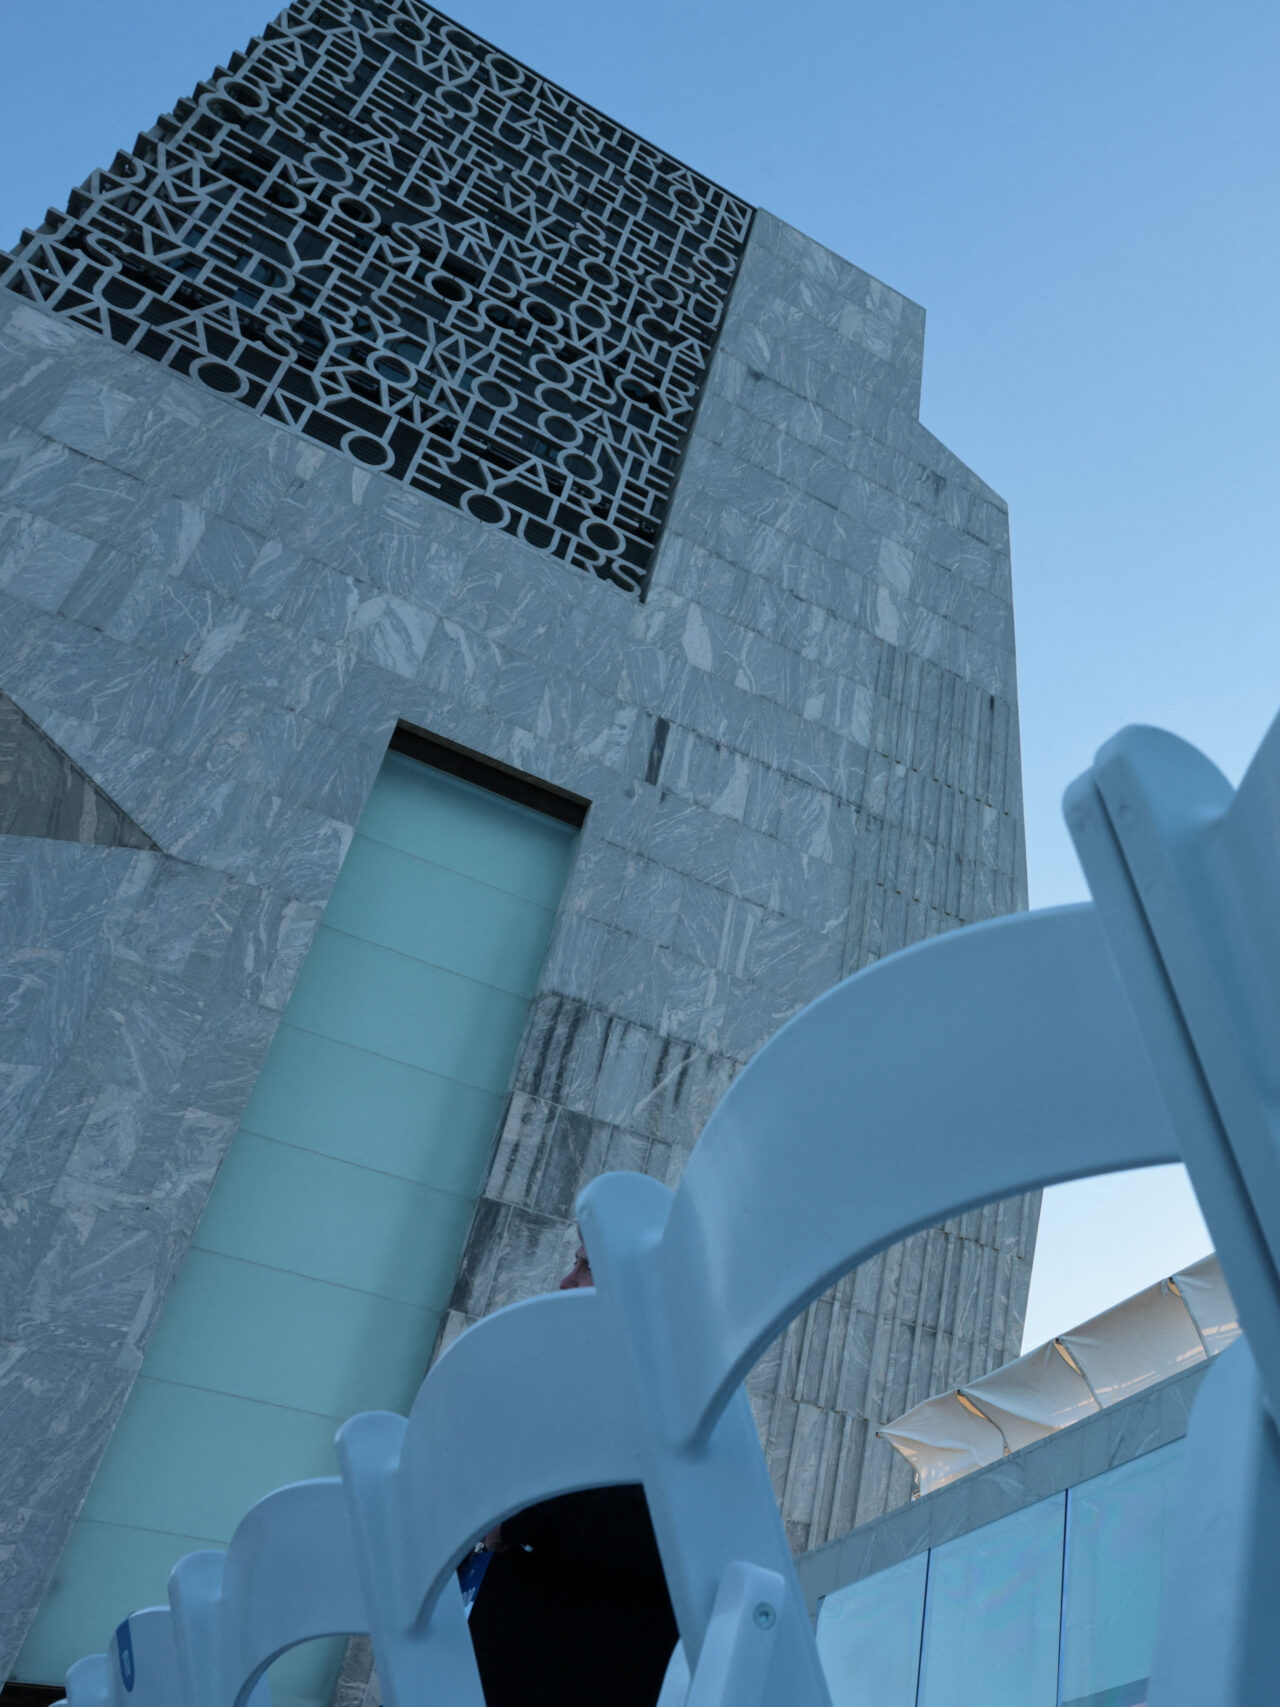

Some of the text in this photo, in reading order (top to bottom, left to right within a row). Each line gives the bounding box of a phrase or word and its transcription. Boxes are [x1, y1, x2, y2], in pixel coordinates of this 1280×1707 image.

[262, 29, 727, 311] ARE FIRST STEPS
[266, 155, 452, 270] MOST
[345, 100, 409, 145] IS
[416, 139, 558, 233] NEW
[404, 44, 573, 155] WHAT
[602, 161, 652, 204] IS
[430, 81, 648, 221] OUGHT
[674, 223, 737, 275] TO
[519, 154, 580, 201] IN
[600, 201, 719, 285] THIS
[139, 143, 682, 449] WE THE PEOPLE
[252, 174, 691, 429] DEMOCRACY
[296, 146, 401, 215] OF
[410, 208, 548, 298] ANY
[566, 293, 698, 384] ONE
[355, 129, 495, 220] ARE
[522, 222, 704, 342] MORE
[452, 207, 711, 368] AMERICA
[0, 258, 647, 601] NATION OF OURS
[73, 198, 657, 516] EVERYONE OH
[158, 273, 368, 394] TASK
[369, 378, 494, 460] WE
[508, 447, 644, 538] ARE
[272, 240, 411, 328] YES
[415, 314, 527, 391] WE
[530, 374, 665, 466] CAN
[306, 287, 410, 356] BY
[414, 342, 523, 416] NO
[533, 403, 673, 496] ONE
[377, 412, 517, 502] TRY
[543, 494, 632, 561] TO
